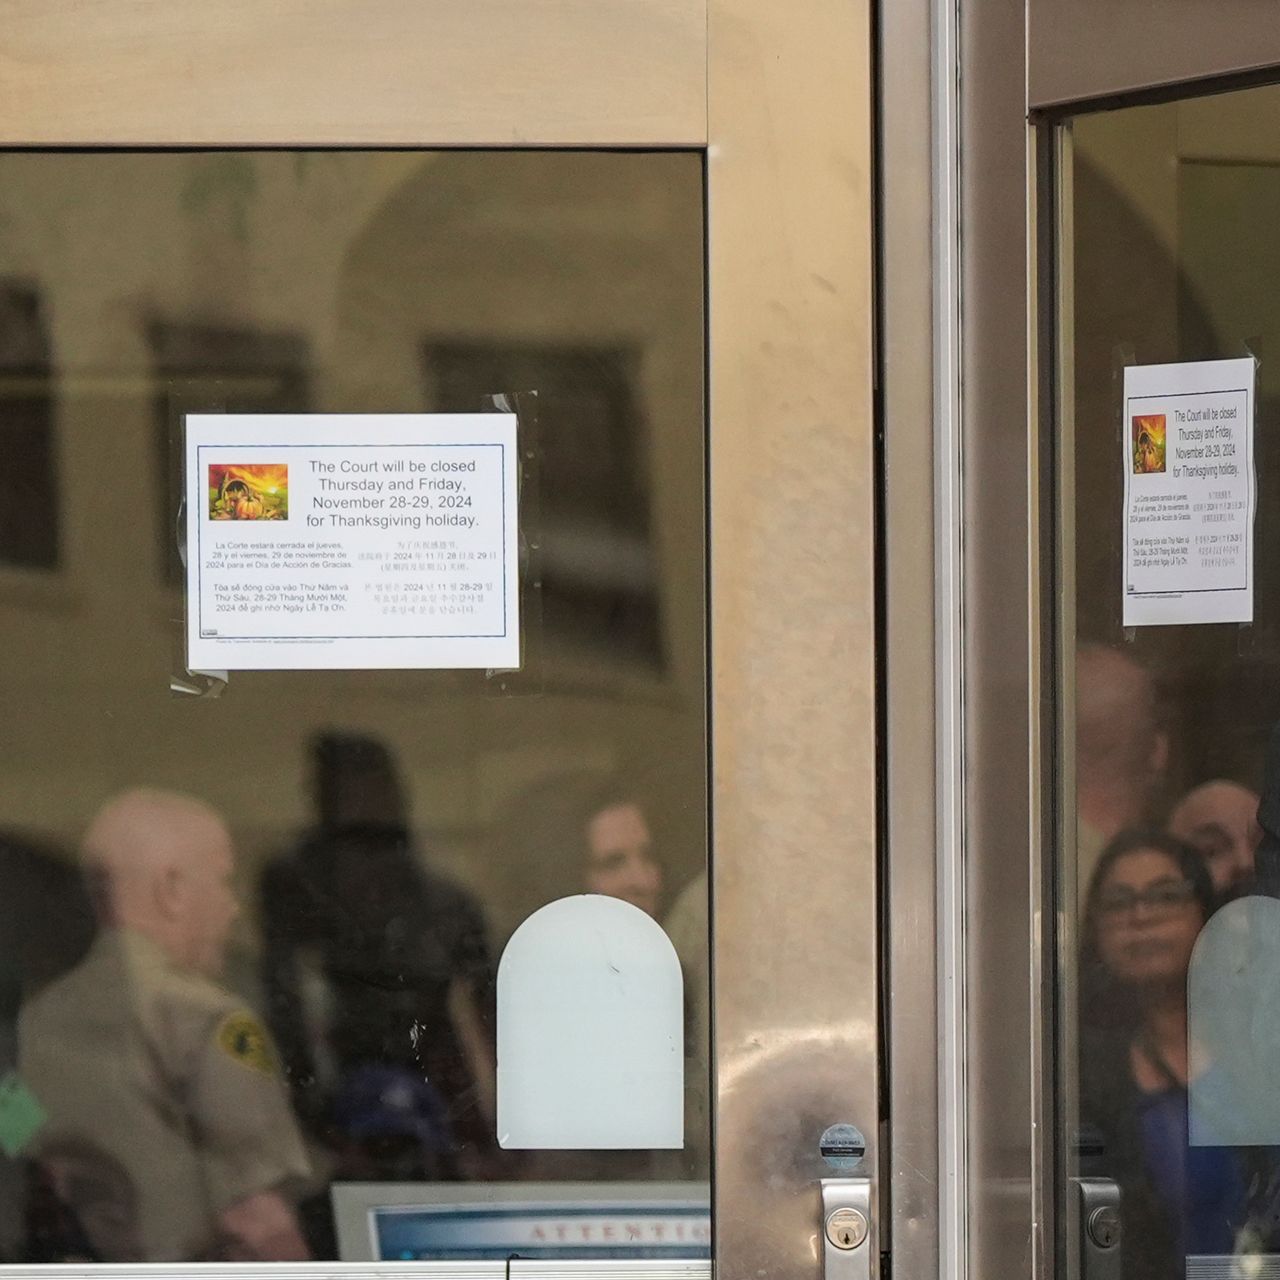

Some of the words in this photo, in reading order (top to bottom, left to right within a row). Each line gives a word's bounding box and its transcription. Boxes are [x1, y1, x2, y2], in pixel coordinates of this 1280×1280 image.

[1174, 410, 1186, 422] The
[1186, 409, 1202, 422] Court
[1202, 408, 1211, 420] will
[1211, 408, 1218, 420] be
[1219, 406, 1237, 419] closed
[1178, 428, 1203, 442] Thursday
[1204, 426, 1214, 439] and
[1176, 446, 1204, 459] November
[1222, 443, 1236, 456] 2024
[308, 460, 335, 473] The
[340, 460, 378, 473] Court
[382, 460, 404, 472] will
[409, 460, 426, 472] be
[430, 460, 476, 472] closed
[1173, 465, 1181, 478] for
[1182, 464, 1218, 480] Thanksgiving
[318, 478, 384, 493] Thursday
[388, 478, 414, 490] and
[419, 478, 466, 493] Friday,
[313, 496, 385, 509] November
[389, 496, 433, 509] 28-29,
[438, 495, 472, 508] 2024
[306, 514, 325, 527] for
[329, 514, 421, 530] Thanksgiving
[426, 513, 479, 529] holiday.
[215, 541, 226, 549] La
[226, 541, 249, 549] Corte
[276, 541, 305, 549] cerrada
[307, 541, 315, 549] el
[212, 551, 223, 559] 28
[224, 553, 230, 561] y
[230, 551, 238, 559] el
[272, 551, 282, 559] 29
[283, 551, 294, 559] de
[295, 551, 335, 559] noviembre
[337, 551, 347, 559] de
[205, 561, 226, 569] 2024
[227, 562, 244, 570] para
[246, 561, 253, 569] el
[270, 561, 281, 569] de
[310, 560, 320, 568] de
[254, 593, 278, 602] 28-29
